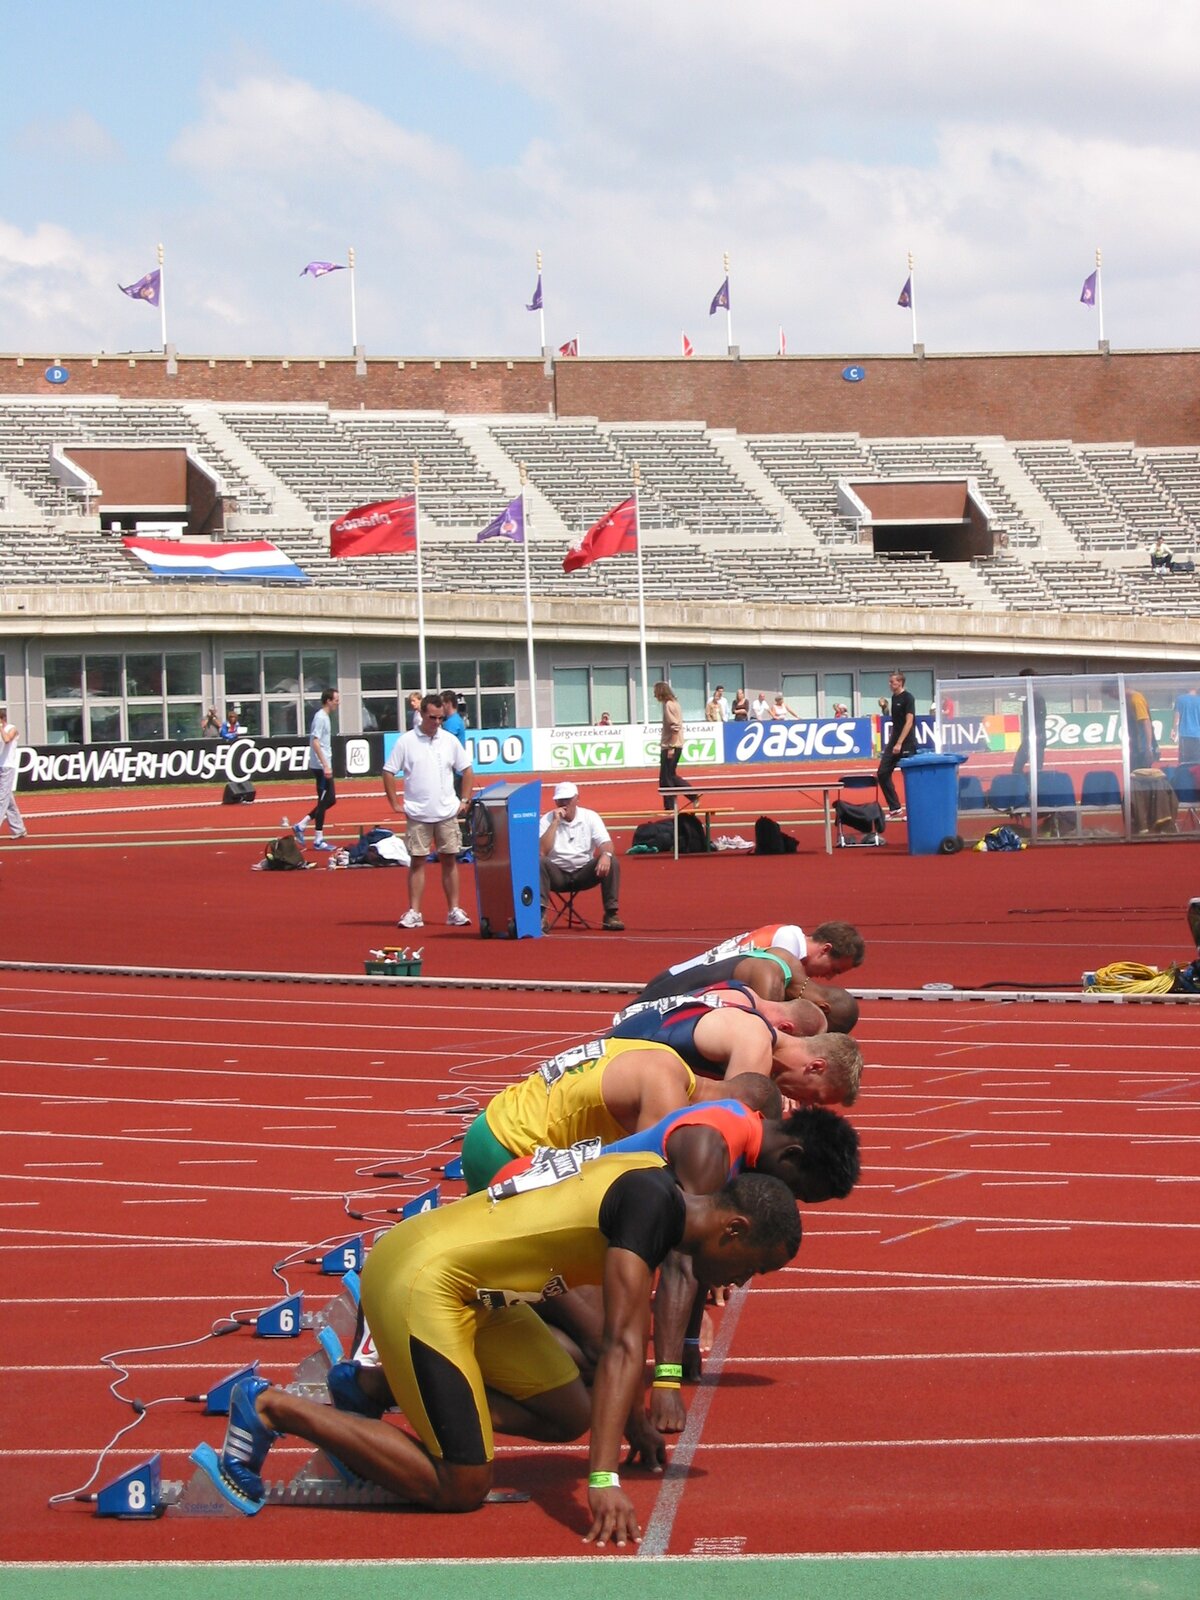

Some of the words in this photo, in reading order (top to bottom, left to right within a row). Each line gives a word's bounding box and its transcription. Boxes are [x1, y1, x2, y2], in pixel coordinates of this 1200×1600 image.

[54, 369, 62, 379] D
[850, 368, 858, 378] C
[343, 1249, 356, 1269] 5
[279, 1309, 294, 1332] 6
[128, 1480, 146, 1509] 8
